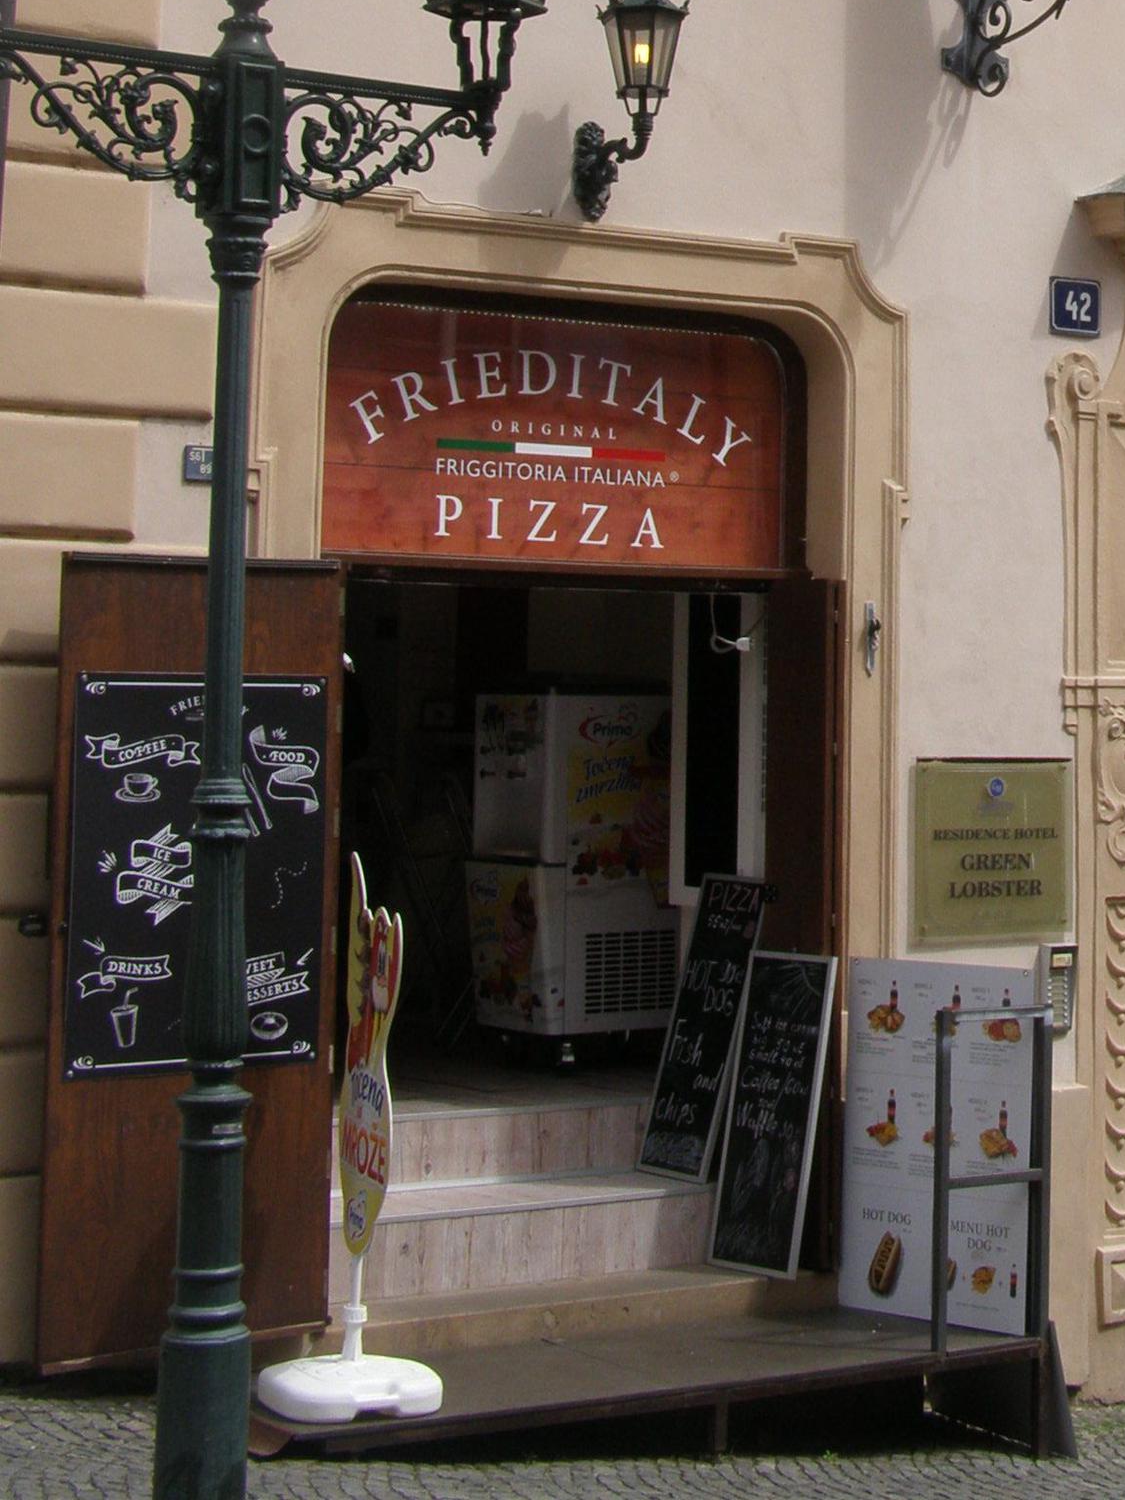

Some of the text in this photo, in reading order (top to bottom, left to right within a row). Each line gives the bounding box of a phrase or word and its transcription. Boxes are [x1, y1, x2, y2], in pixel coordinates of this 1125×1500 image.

[1065, 290, 1091, 322] 42
[348, 349, 752, 467] FRIEDITALY
[492, 419, 617, 440] ORIGINAL
[436, 458, 567, 482] FRIGGITORIA
[434, 494, 665, 548] PIZZA
[118, 739, 168, 763] COFFEE
[269, 751, 305, 763] FOOD
[933, 827, 1058, 841] RESIDENCE HOTEL
[152, 847, 171, 862] ICE
[960, 853, 1031, 871] GREEN
[137, 878, 181, 900] CREAM
[708, 882, 760, 913] PIZZA
[950, 879, 1042, 899] LOBSTER
[107, 960, 163, 975] DRINKS
[246, 958, 276, 975] EET
[681, 959, 718, 991] HOT
[247, 979, 300, 1002] ESSERTS
[703, 986, 734, 1017] DOG
[668, 1019, 703, 1068] Fish
[692, 1062, 724, 1092] and
[862, 1207, 912, 1225] HOT DOG
[950, 1219, 1011, 1239] MENU HOT
[967, 1238, 992, 1251] DOG
